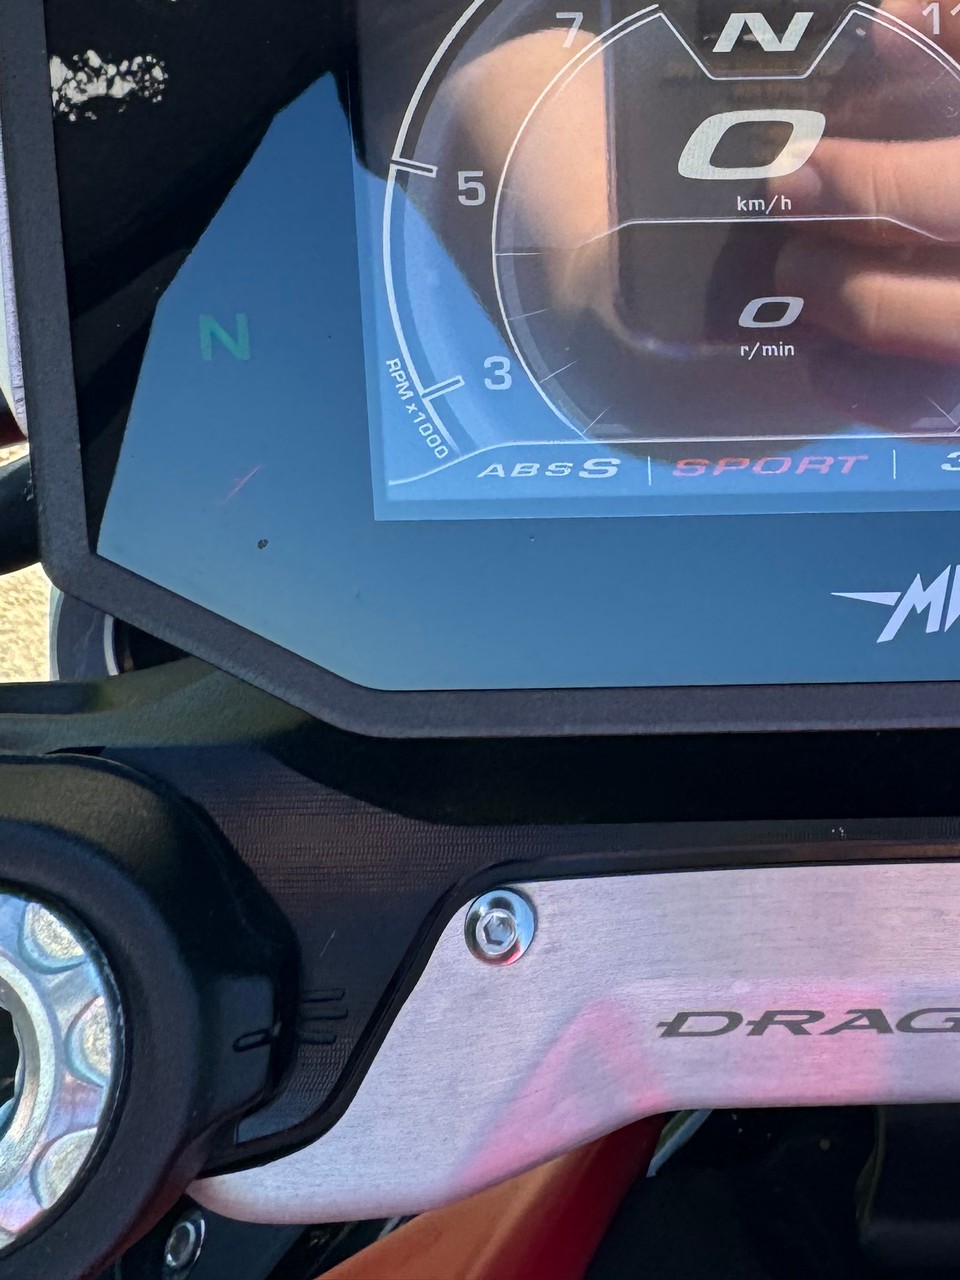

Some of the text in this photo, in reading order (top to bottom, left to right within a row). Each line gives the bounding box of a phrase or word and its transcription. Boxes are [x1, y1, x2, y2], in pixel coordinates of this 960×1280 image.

[554, 10, 585, 49] 7
[711, 11, 815, 53] N
[677, 108, 827, 180] 0
[457, 169, 487, 207] 5
[735, 194, 793, 216] km/h
[737, 295, 805, 329] 0
[199, 312, 250, 362] N
[739, 340, 796, 361] r/min
[385, 357, 414, 400] RPM
[483, 355, 514, 391] 3
[671, 454, 869, 477] SPORT
